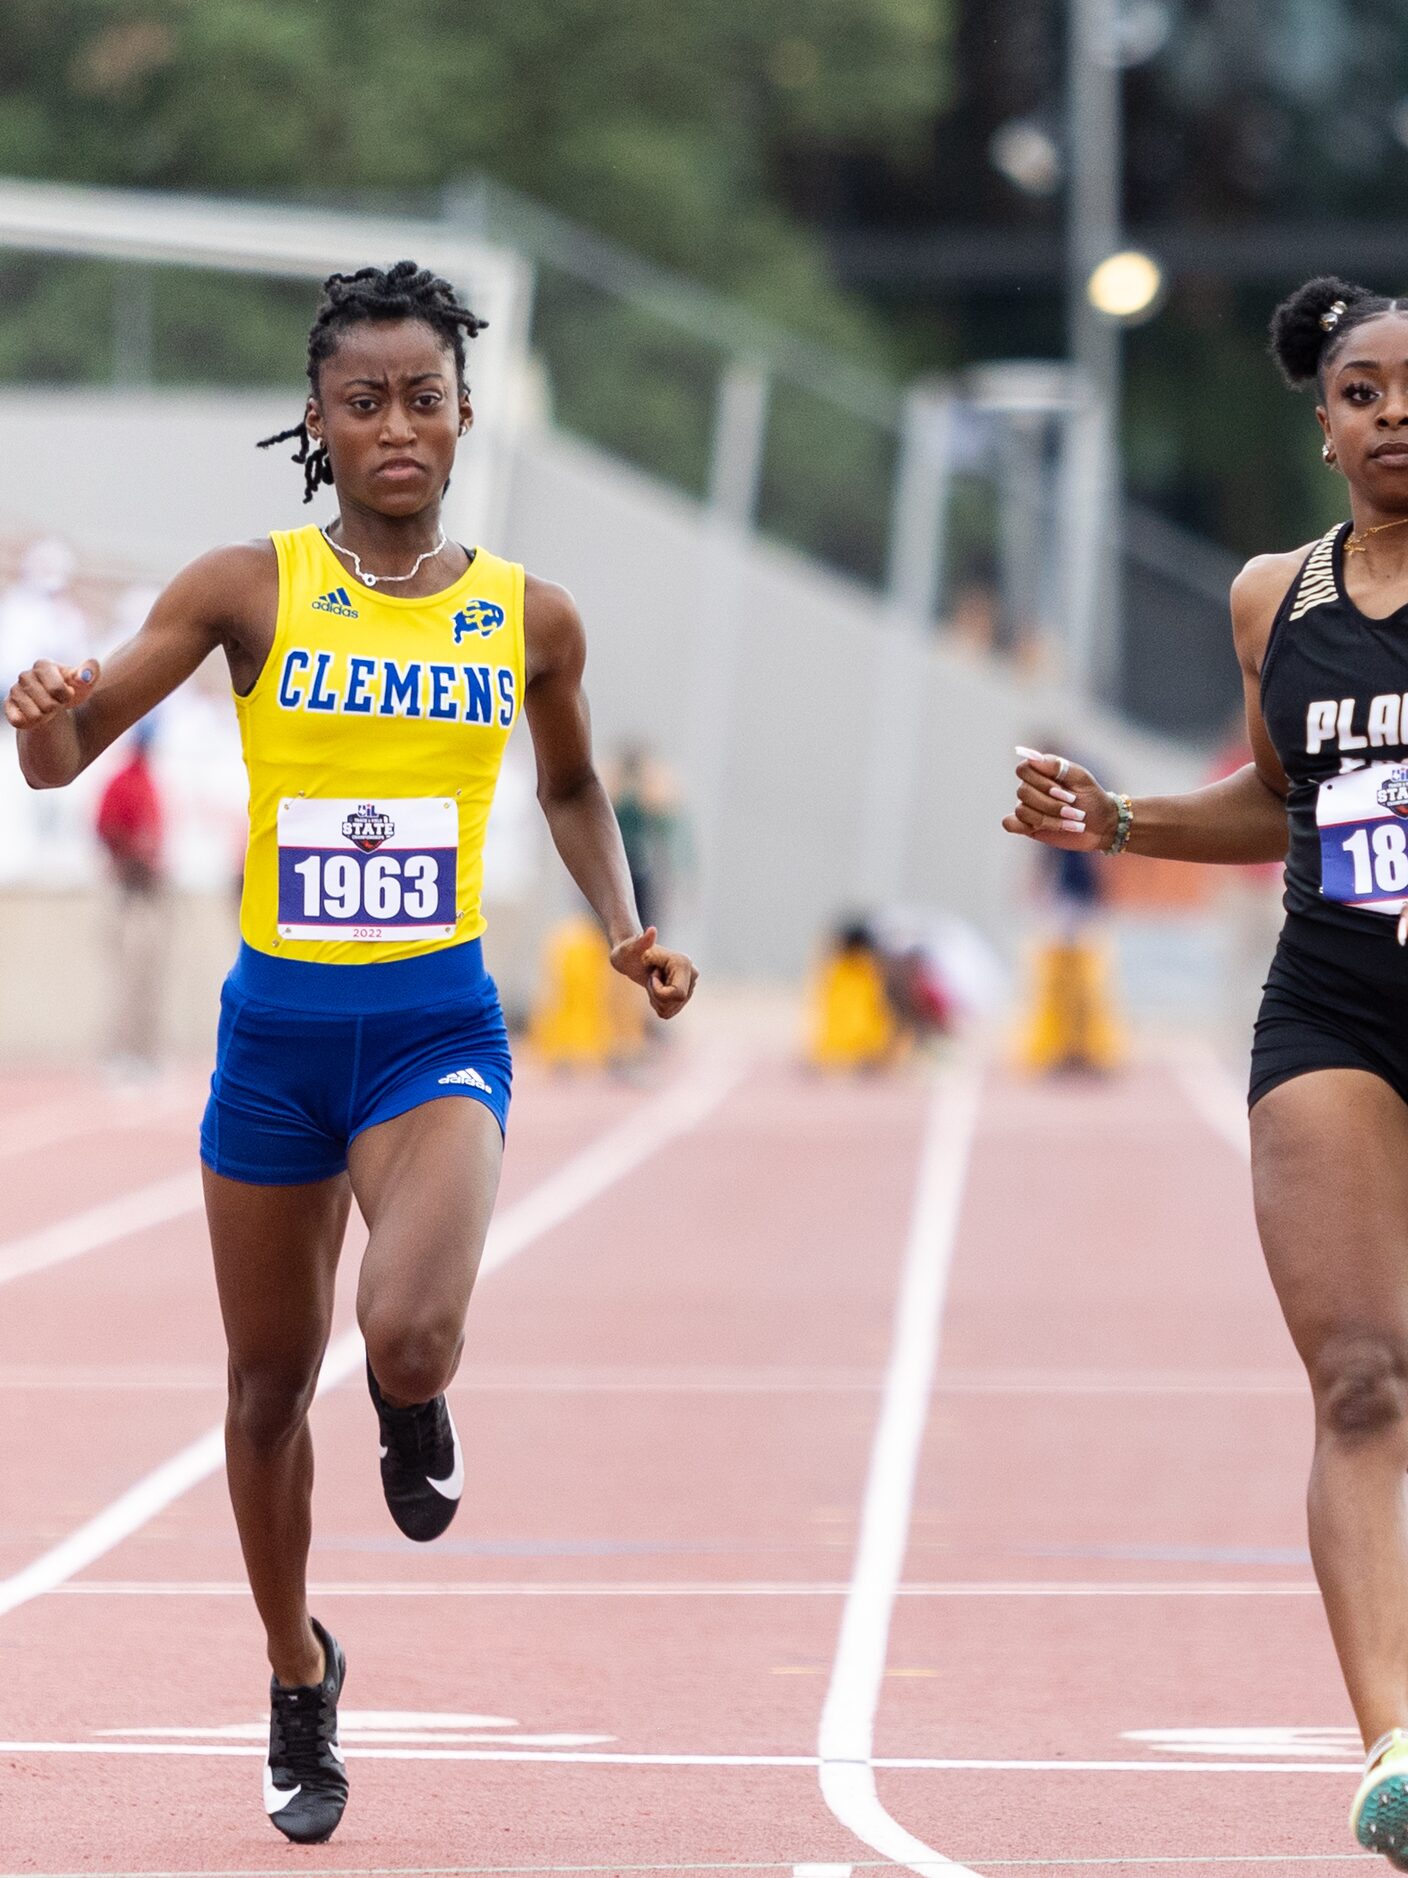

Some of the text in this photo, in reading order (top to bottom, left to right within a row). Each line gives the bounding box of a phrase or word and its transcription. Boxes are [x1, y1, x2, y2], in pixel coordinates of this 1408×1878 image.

[311, 600, 359, 619] adidas
[277, 649, 515, 729] CLEMENS
[341, 822, 395, 836] STATE
[294, 854, 439, 919] 1963
[352, 928, 383, 939] 2022
